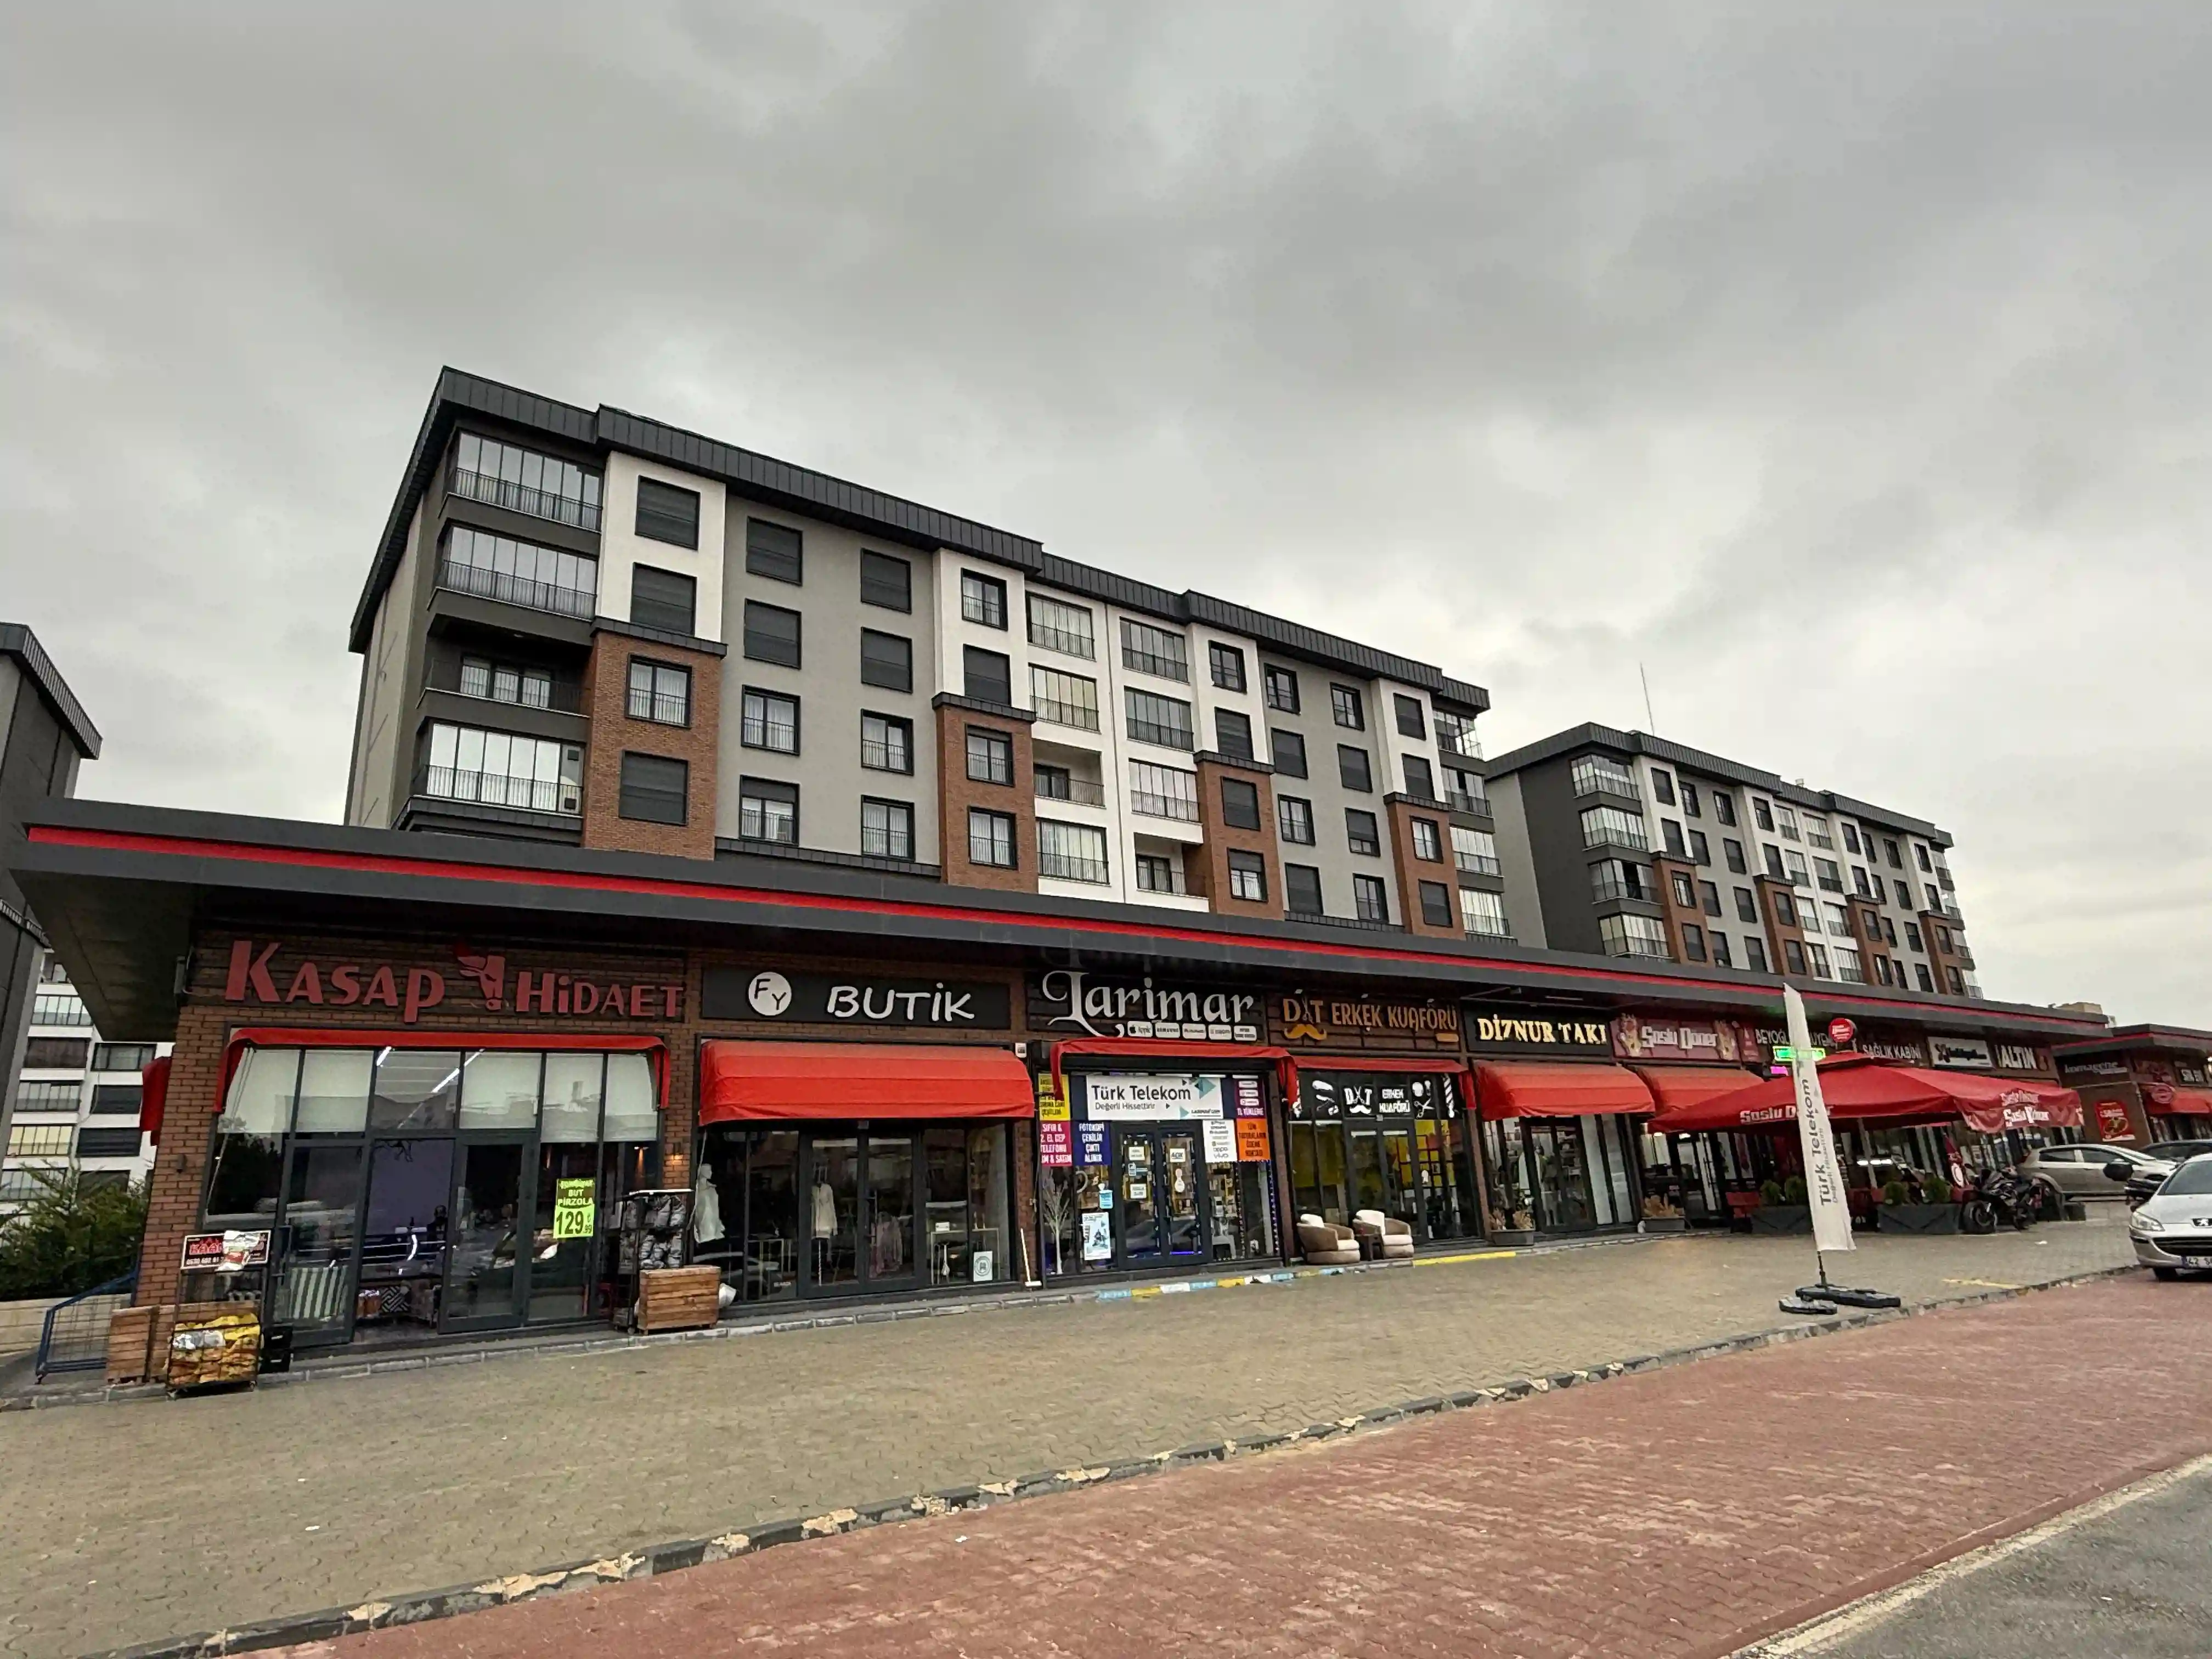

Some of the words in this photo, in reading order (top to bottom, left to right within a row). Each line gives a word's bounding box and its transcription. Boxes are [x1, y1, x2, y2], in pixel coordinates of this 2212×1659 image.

[827, 982, 975, 1022] BUTİK
[1331, 1002, 1383, 1027] ERKEK
[1558, 1023, 1607, 1045] TAKI
[1755, 1029, 1791, 1045] BEYOĞL
[1091, 1085, 1125, 1101] Türk
[1130, 1085, 1190, 1101] Telekom
[1740, 1107, 1782, 1124] Soslu
[1802, 1079, 1821, 1156] Telekom
[568, 1189, 584, 1197] BUT
[1815, 1164, 1831, 1205] Türk
[557, 1197, 592, 1206] PİRZOLA
[556, 1211, 584, 1234] 129
